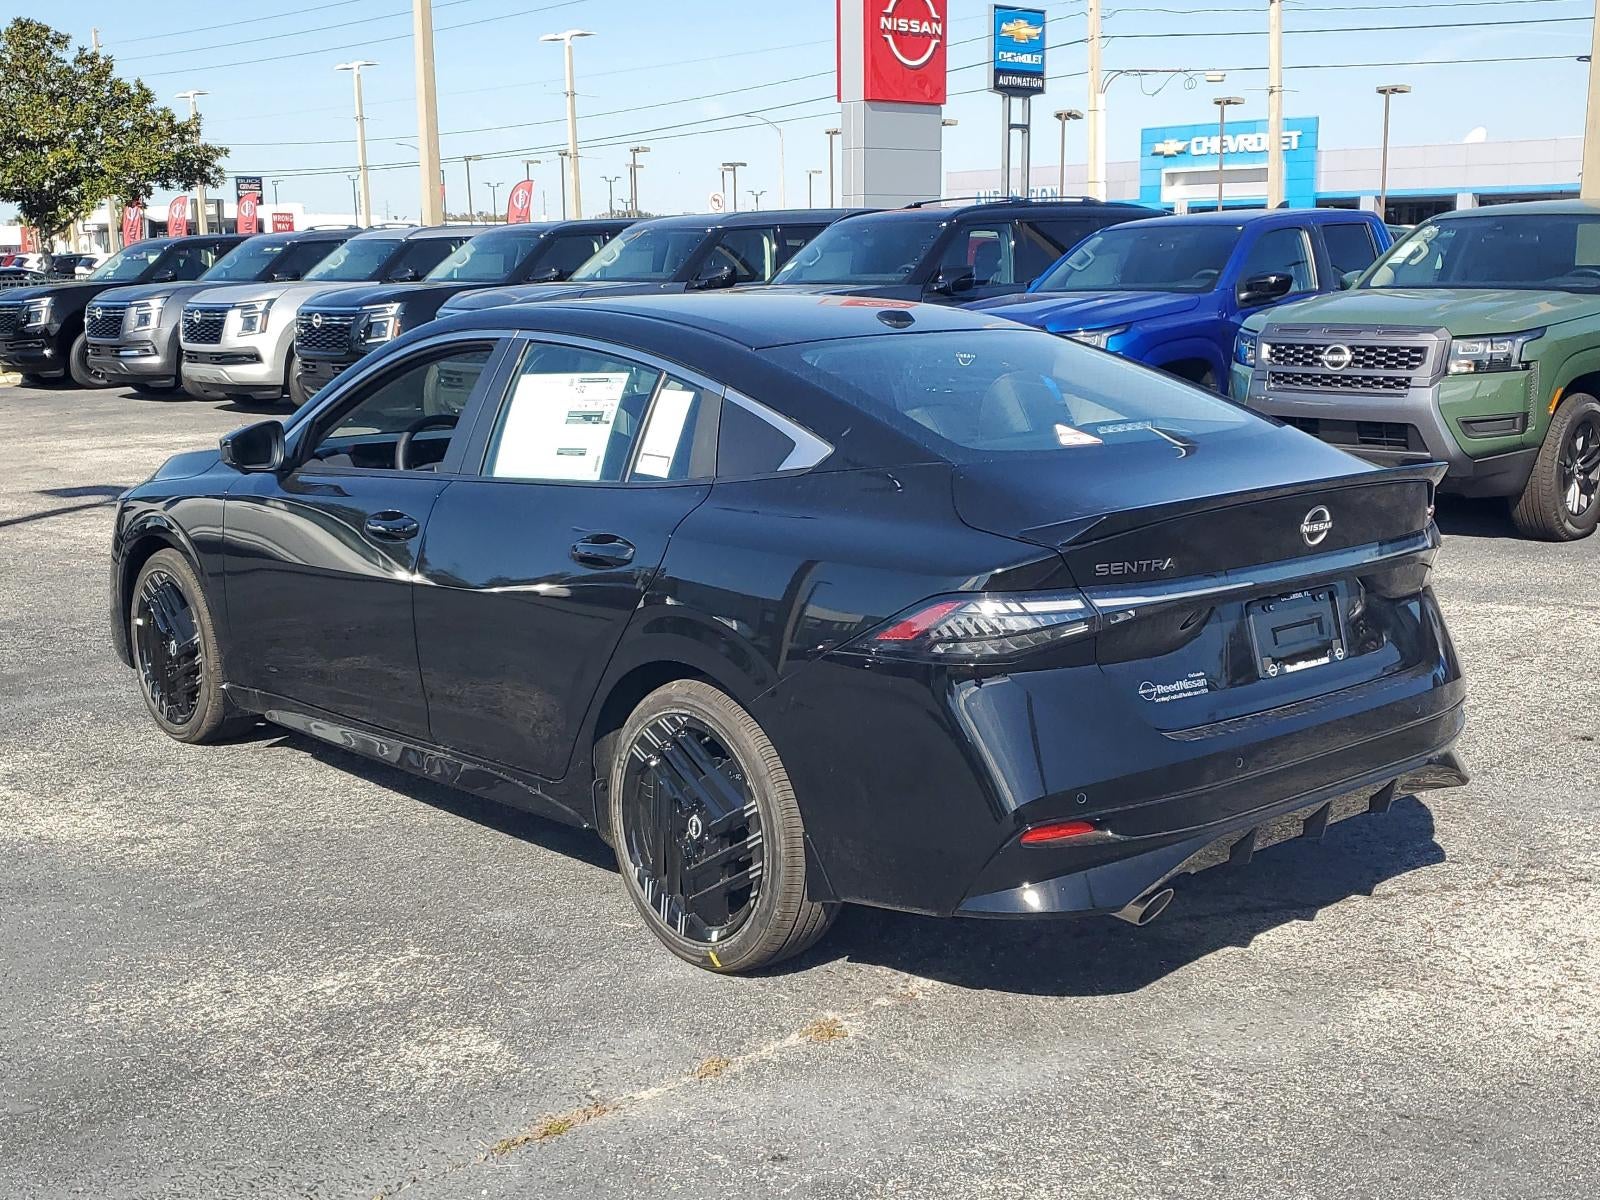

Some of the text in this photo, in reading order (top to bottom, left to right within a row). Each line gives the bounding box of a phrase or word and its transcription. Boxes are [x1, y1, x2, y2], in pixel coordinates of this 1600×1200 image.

[880, 16, 942, 35] NISSAN
[999, 51, 1043, 64] CHEVROLET
[998, 75, 1043, 88] AUTONATION
[272, 214, 294, 222] WRONG
[276, 222, 290, 231] WAY
[1301, 521, 1333, 533] NISSAN
[1096, 558, 1175, 576] SENTRA
